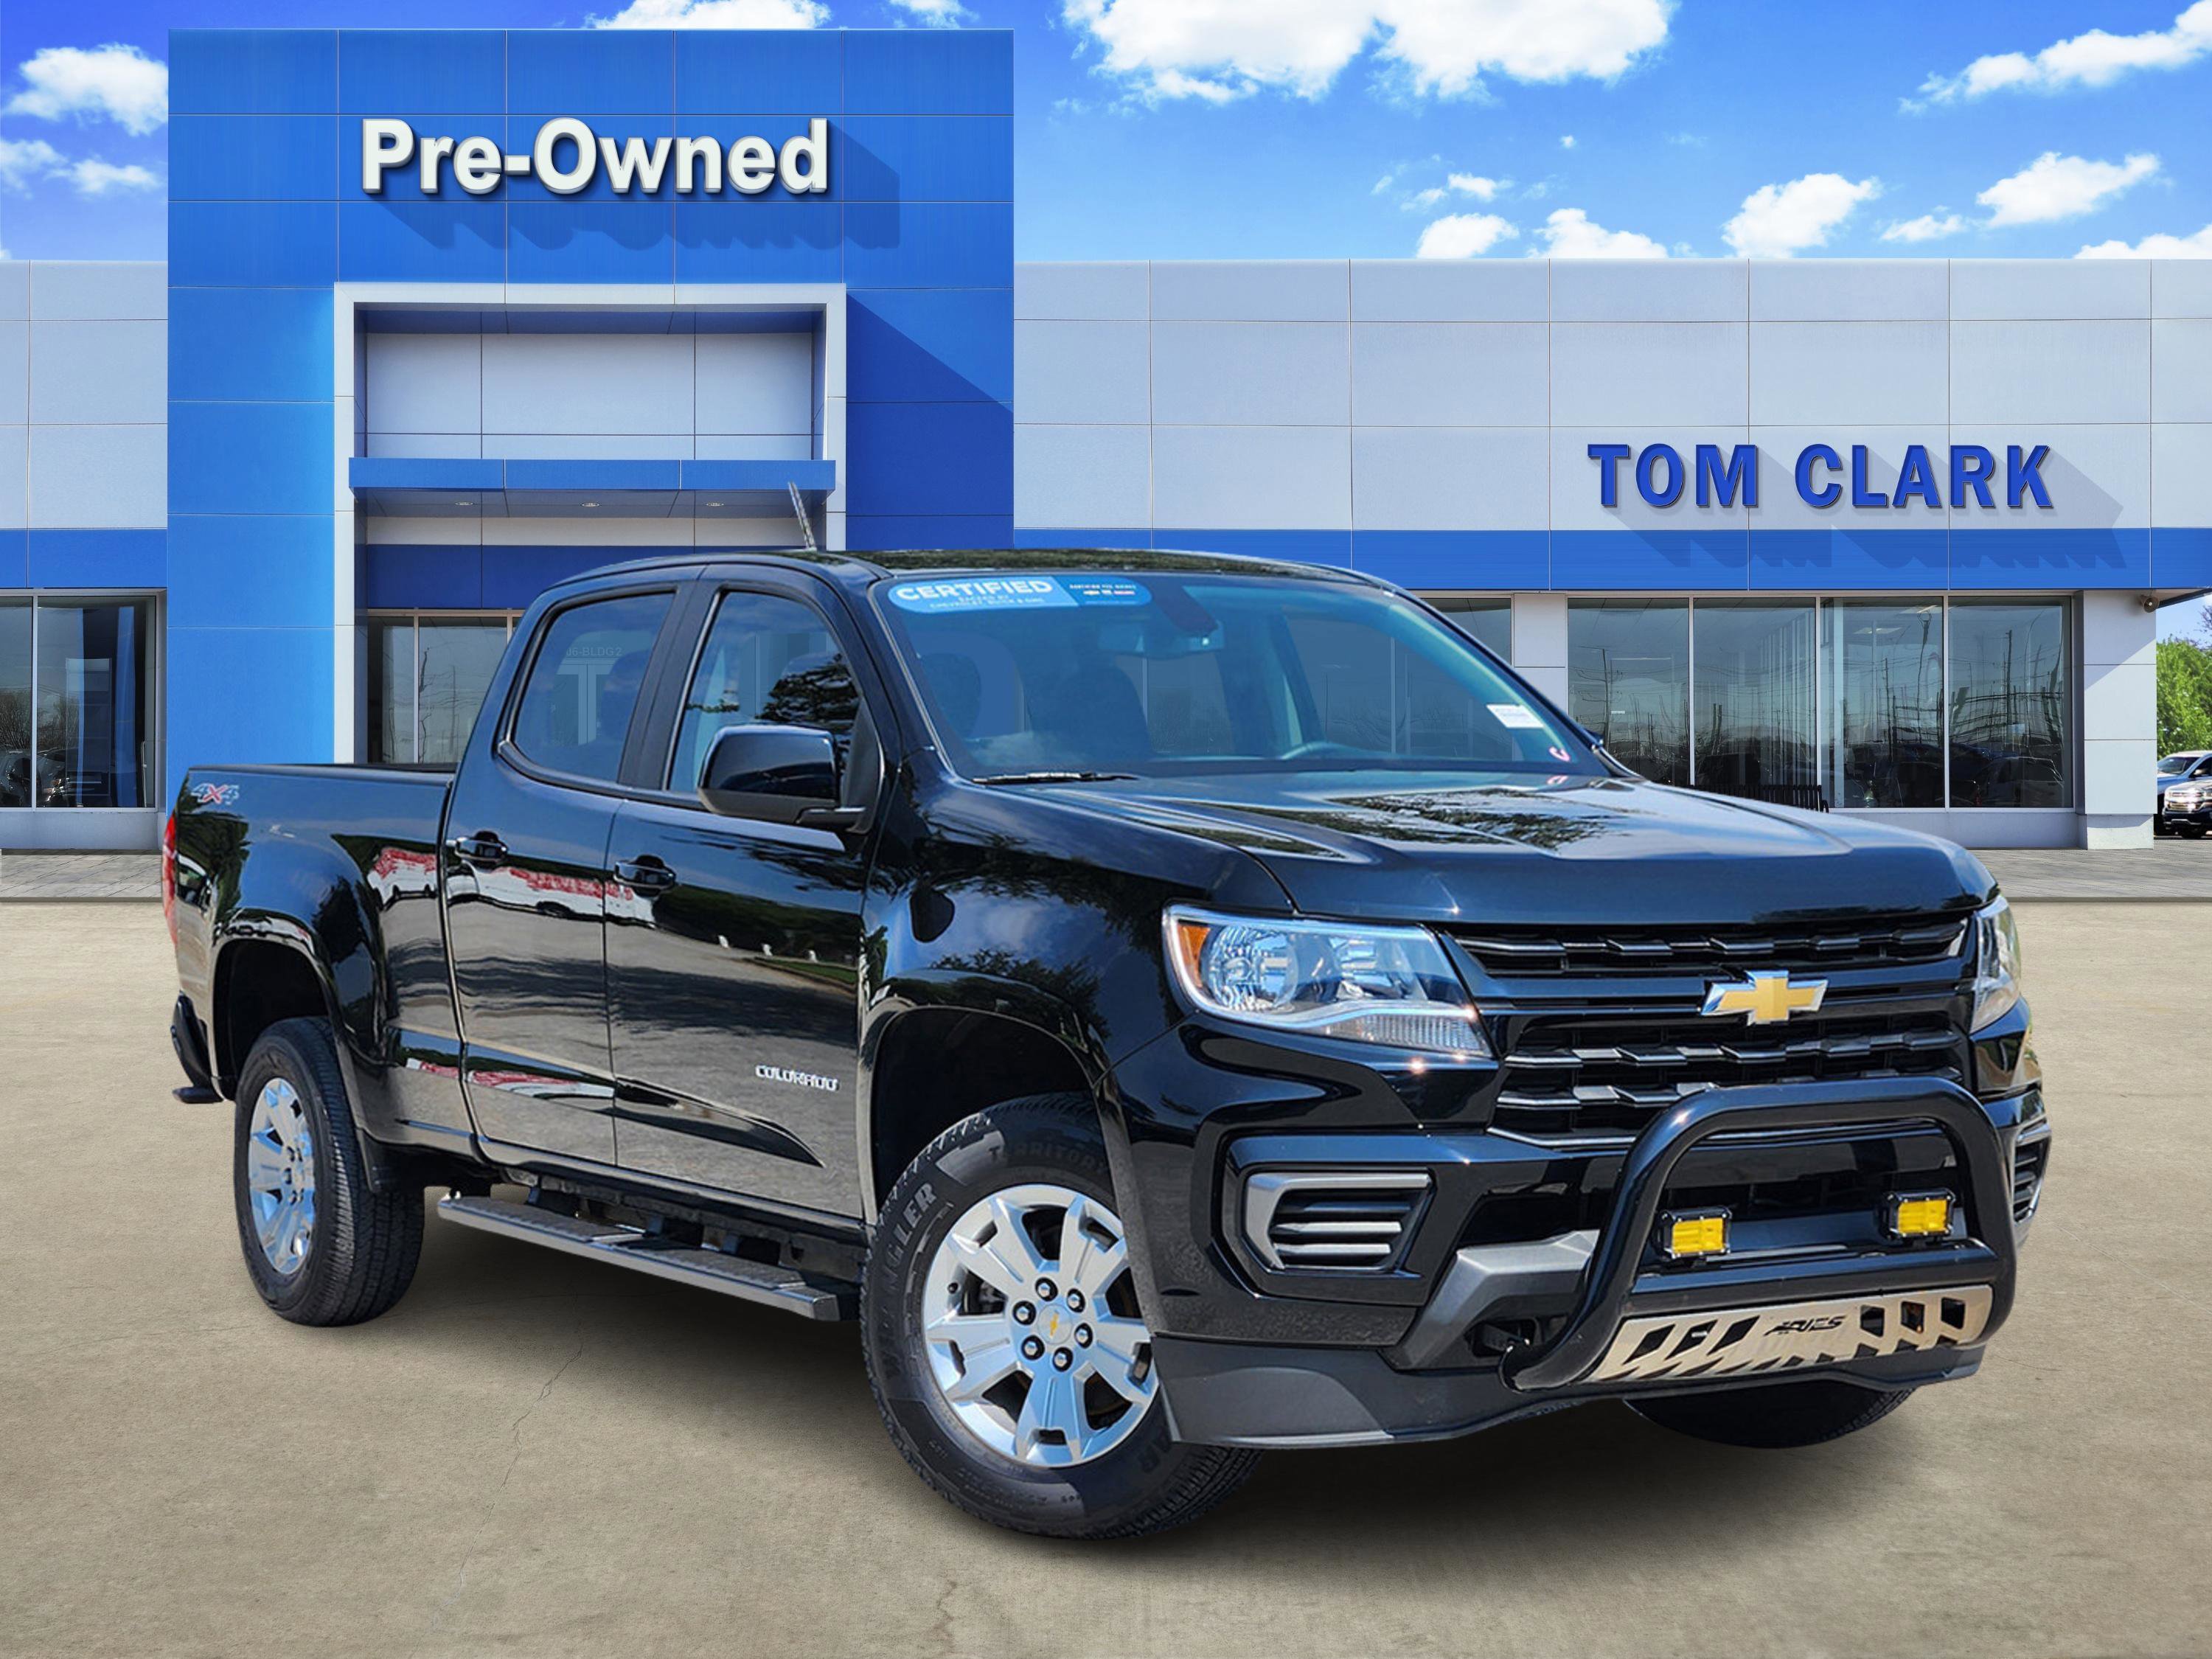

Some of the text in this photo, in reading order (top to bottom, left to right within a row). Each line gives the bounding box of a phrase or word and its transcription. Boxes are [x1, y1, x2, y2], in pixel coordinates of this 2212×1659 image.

[361, 116, 829, 194] Pre-Owned
[1587, 443, 2055, 509] TOM CLARK
[894, 580, 1054, 601] CERTIFIED
[755, 1065, 839, 1092] COLORADO
